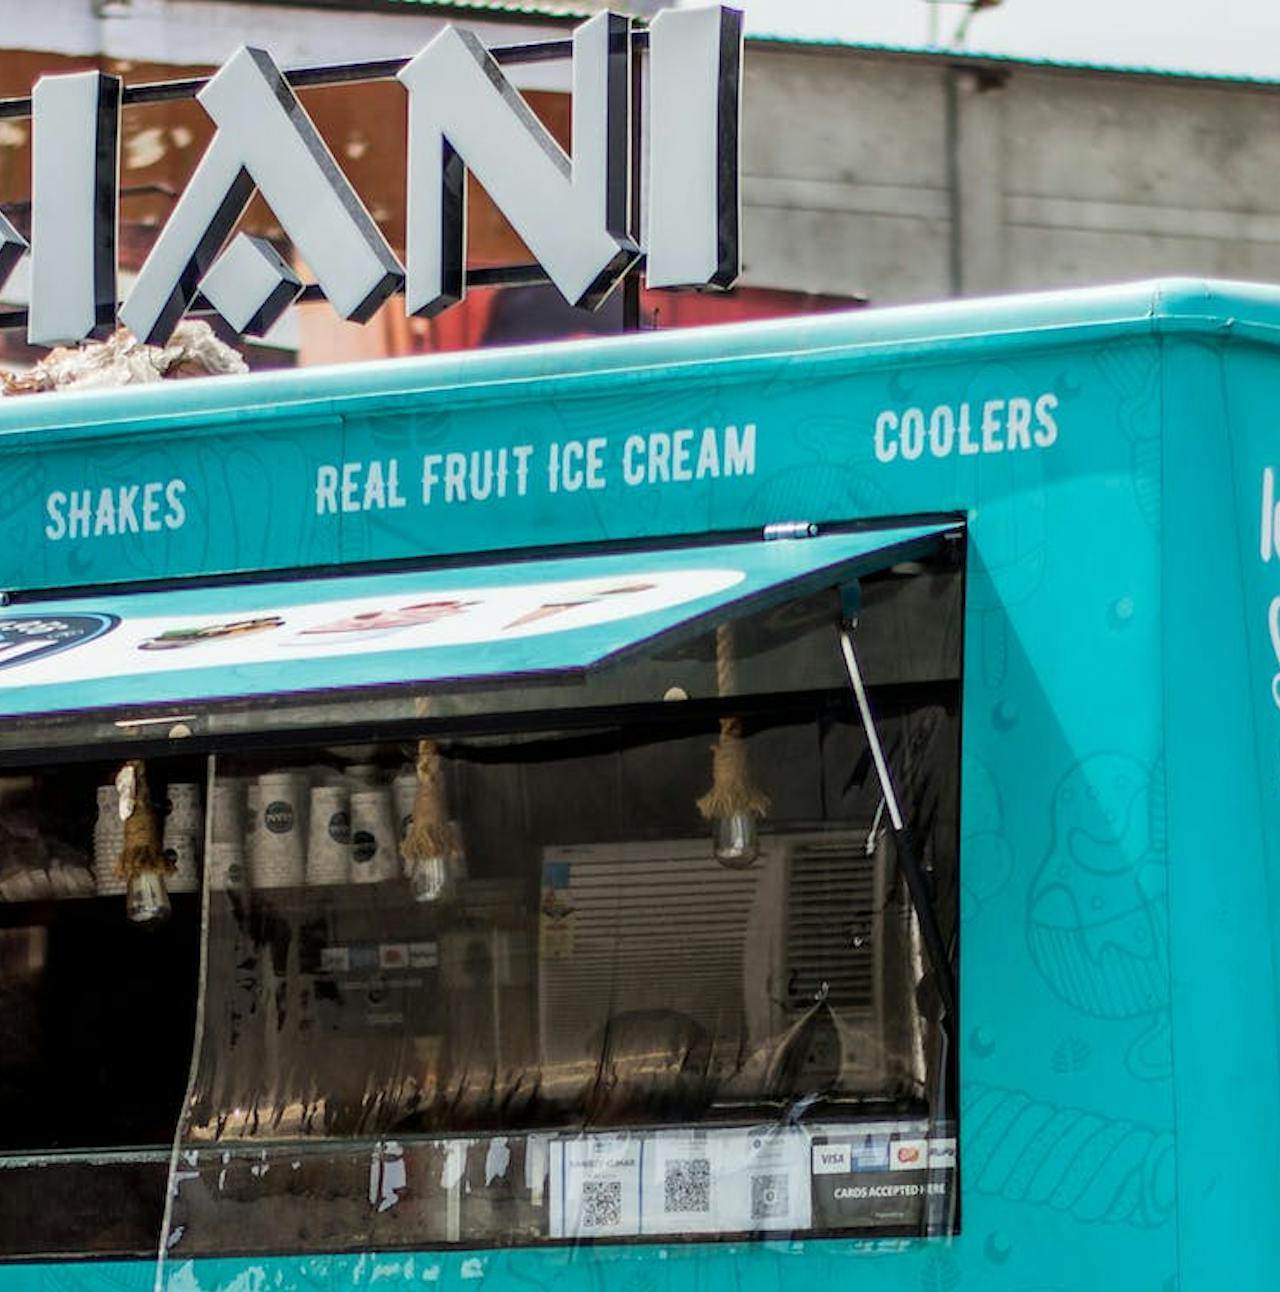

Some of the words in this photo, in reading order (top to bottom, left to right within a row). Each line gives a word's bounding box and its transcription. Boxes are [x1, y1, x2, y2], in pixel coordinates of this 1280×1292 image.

[874, 394, 1058, 462] COOLERS
[316, 459, 405, 514] REAL
[422, 446, 533, 504] FRUIT
[549, 438, 607, 492] ICE
[623, 424, 756, 485] CREAM
[46, 480, 185, 539] SHAKES
[821, 1153, 844, 1165] VISA
[834, 1186, 867, 1199] CARDS
[869, 1184, 919, 1197] ACCEPTED
